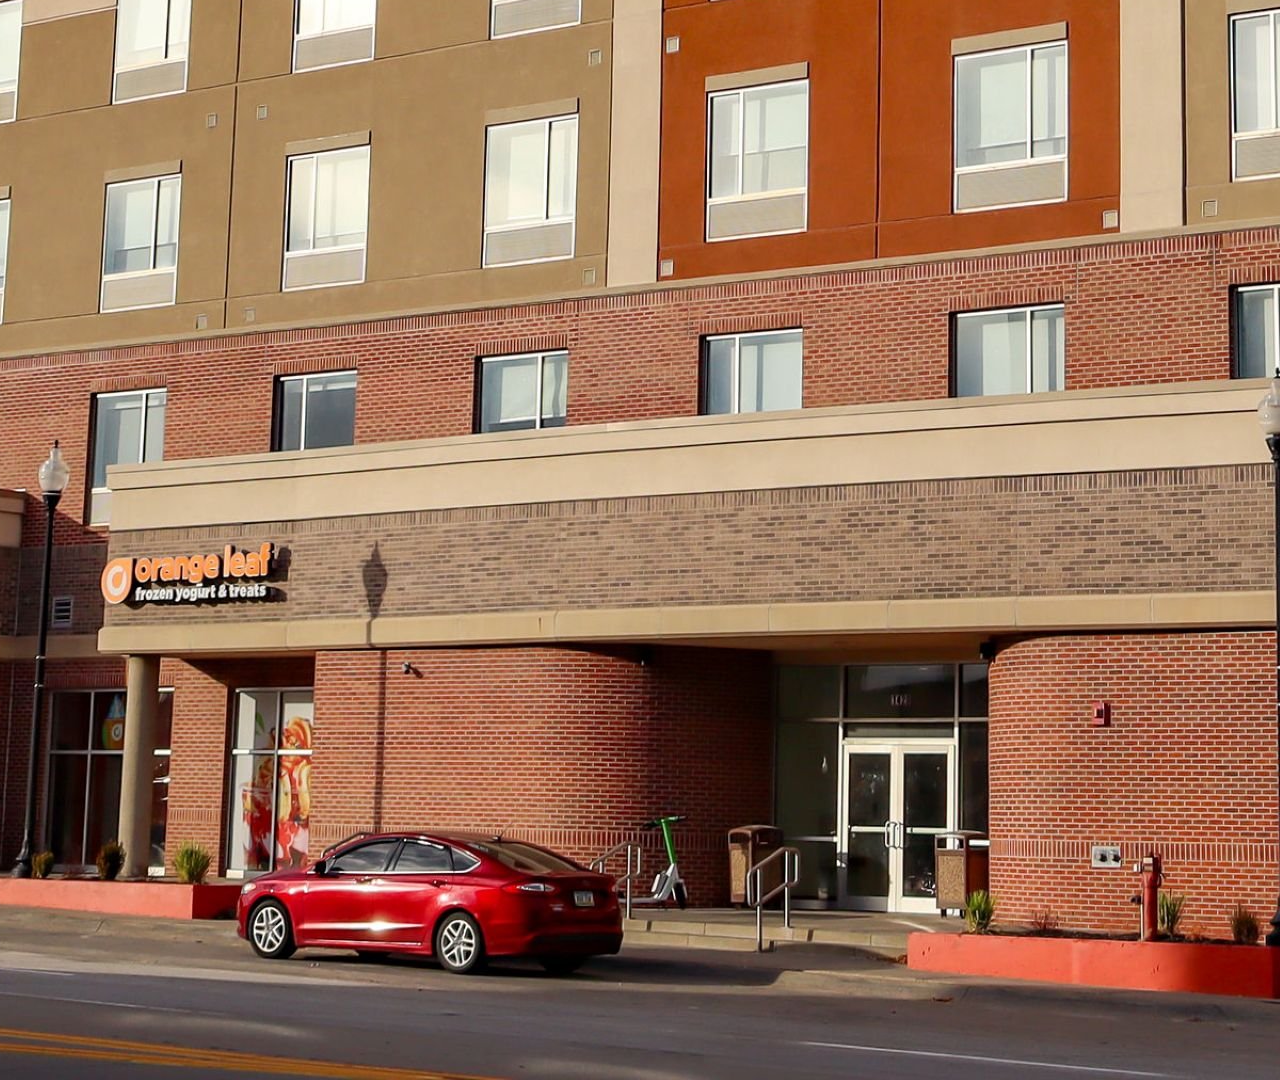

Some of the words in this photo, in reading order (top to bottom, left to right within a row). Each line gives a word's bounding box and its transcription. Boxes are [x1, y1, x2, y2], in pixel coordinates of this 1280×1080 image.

[134, 553, 220, 584] orange
[223, 541, 272, 578] leaf
[135, 586, 174, 601] frozen
[218, 585, 228, 598] &
[228, 583, 267, 599] treats
